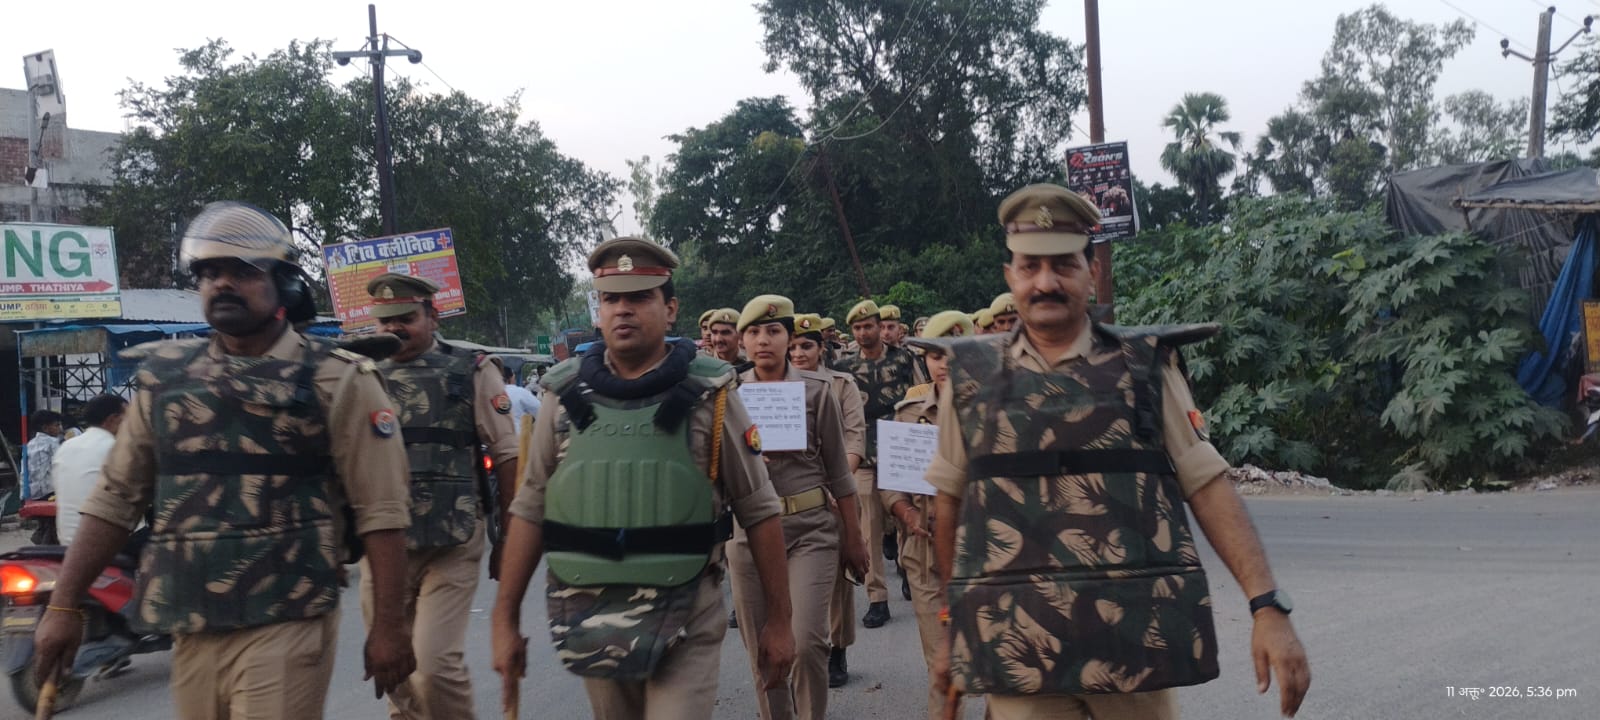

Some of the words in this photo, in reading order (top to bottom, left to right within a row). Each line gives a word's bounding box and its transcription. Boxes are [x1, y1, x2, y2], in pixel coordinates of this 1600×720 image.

[4, 229, 93, 278] NG
[345, 243, 377, 265] शिव
[377, 235, 435, 258] क्लीनिक
[30, 283, 85, 292] THATHIYA
